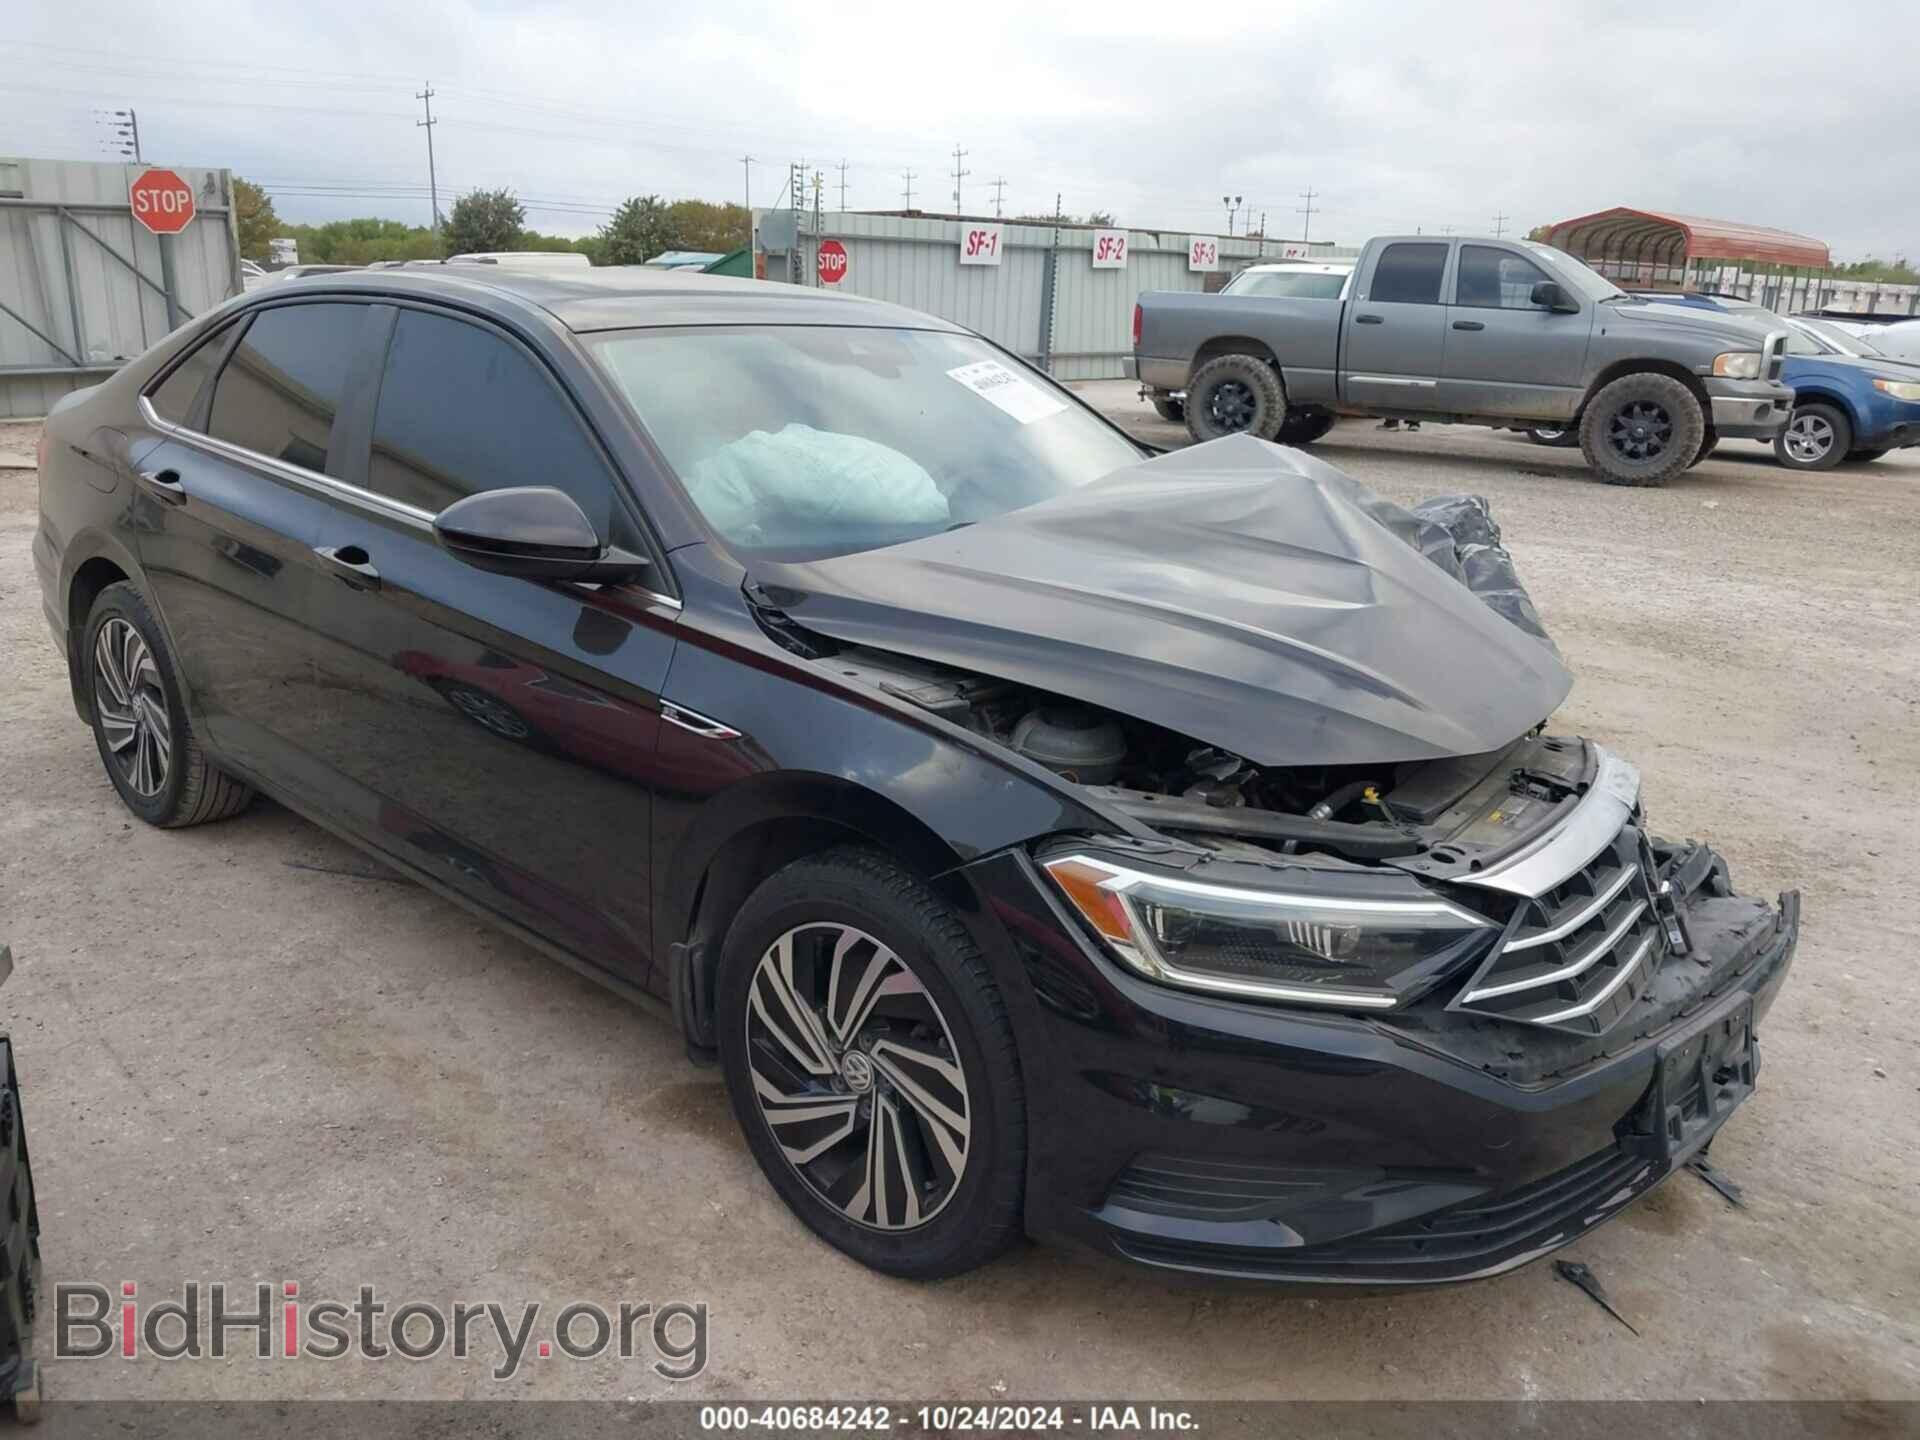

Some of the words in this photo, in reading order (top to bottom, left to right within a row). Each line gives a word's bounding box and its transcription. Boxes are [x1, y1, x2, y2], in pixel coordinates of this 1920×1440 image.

[136, 189, 189, 213] STOP
[967, 230, 998, 256] SF-1
[1097, 238, 1124, 261] SF-2
[1192, 242, 1216, 265] SF-3
[818, 252, 846, 270] STOP
